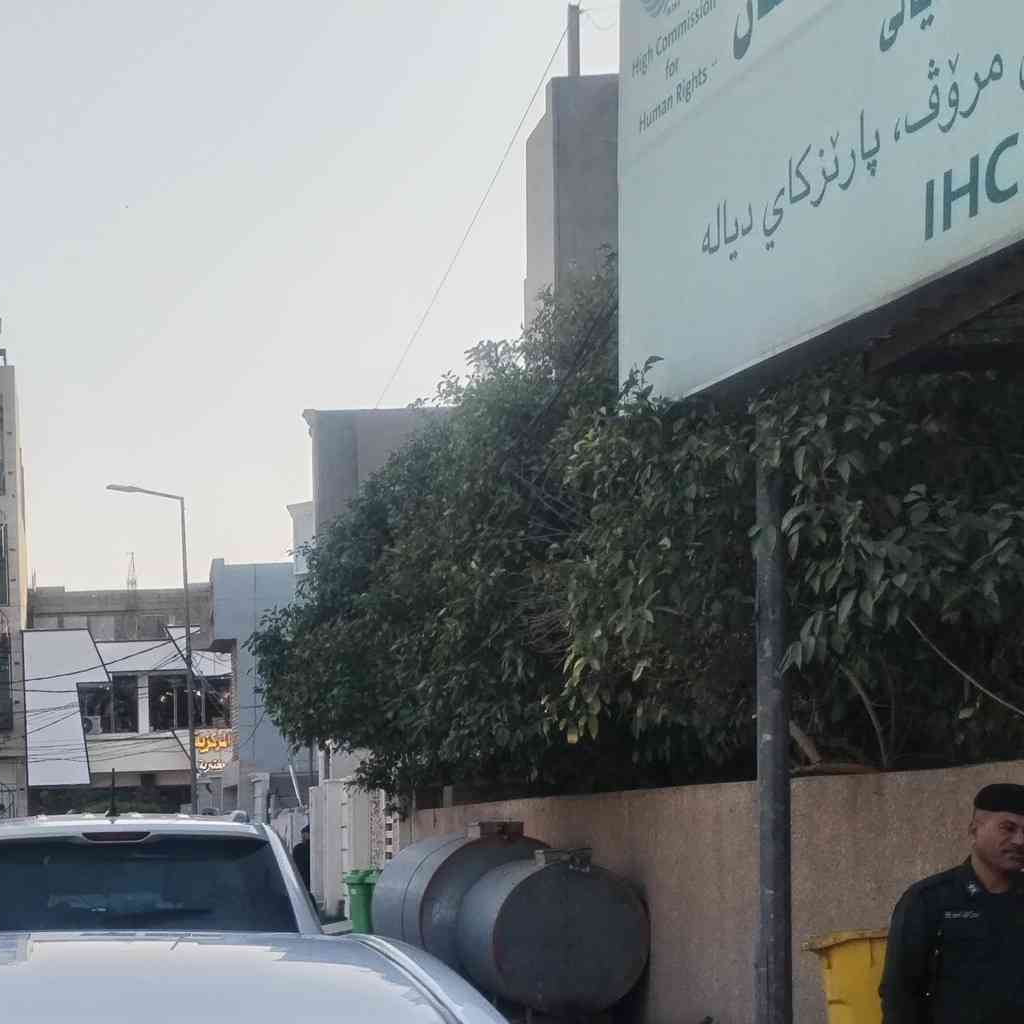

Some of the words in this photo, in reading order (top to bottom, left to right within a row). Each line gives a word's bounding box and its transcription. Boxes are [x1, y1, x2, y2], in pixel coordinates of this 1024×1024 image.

[632, 43, 654, 79] High
[664, 57, 680, 80] for
[639, 94, 674, 134] Human
[676, 67, 708, 104] Rights
[925, 132, 1019, 241] IHC
